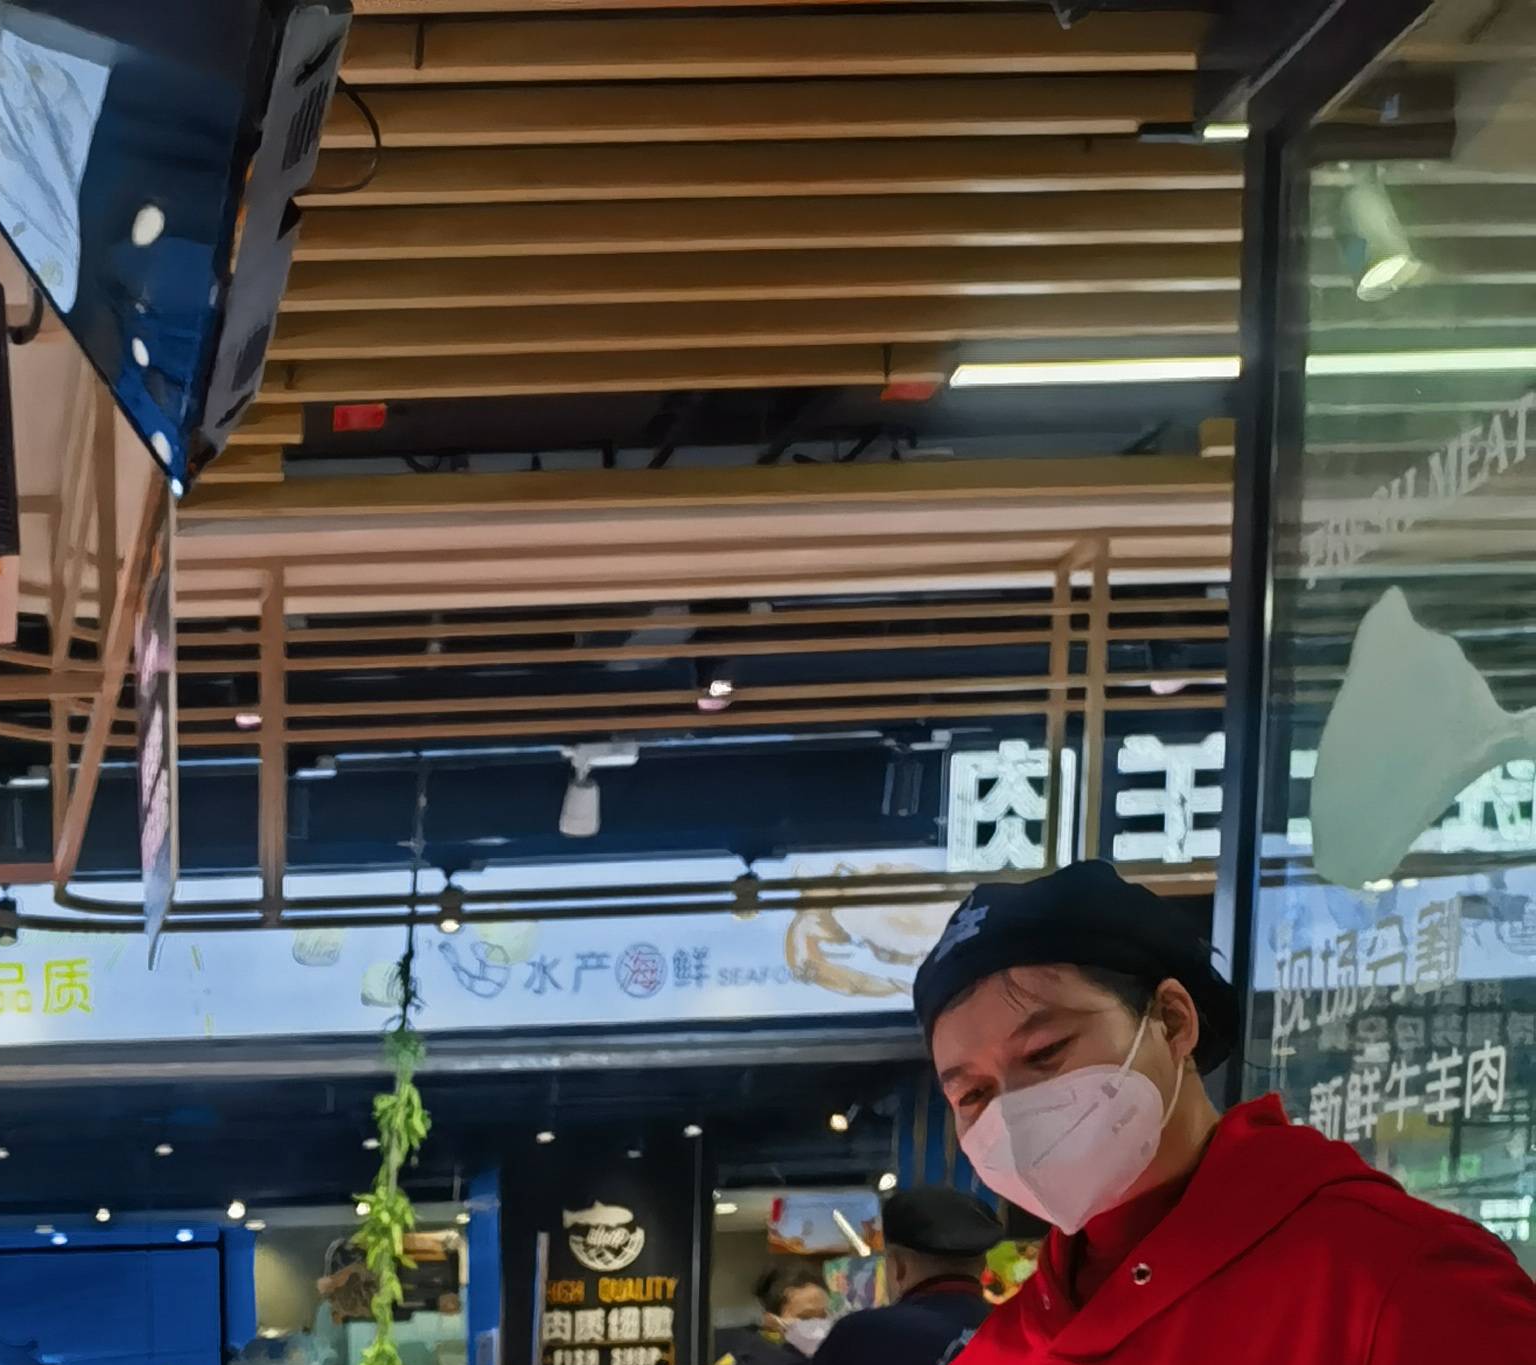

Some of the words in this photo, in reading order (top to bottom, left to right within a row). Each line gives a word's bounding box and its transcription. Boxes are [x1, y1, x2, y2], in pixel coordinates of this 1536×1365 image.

[524, 945, 711, 996] 水产海鲜
[598, 1276, 678, 1303] QUALITY
